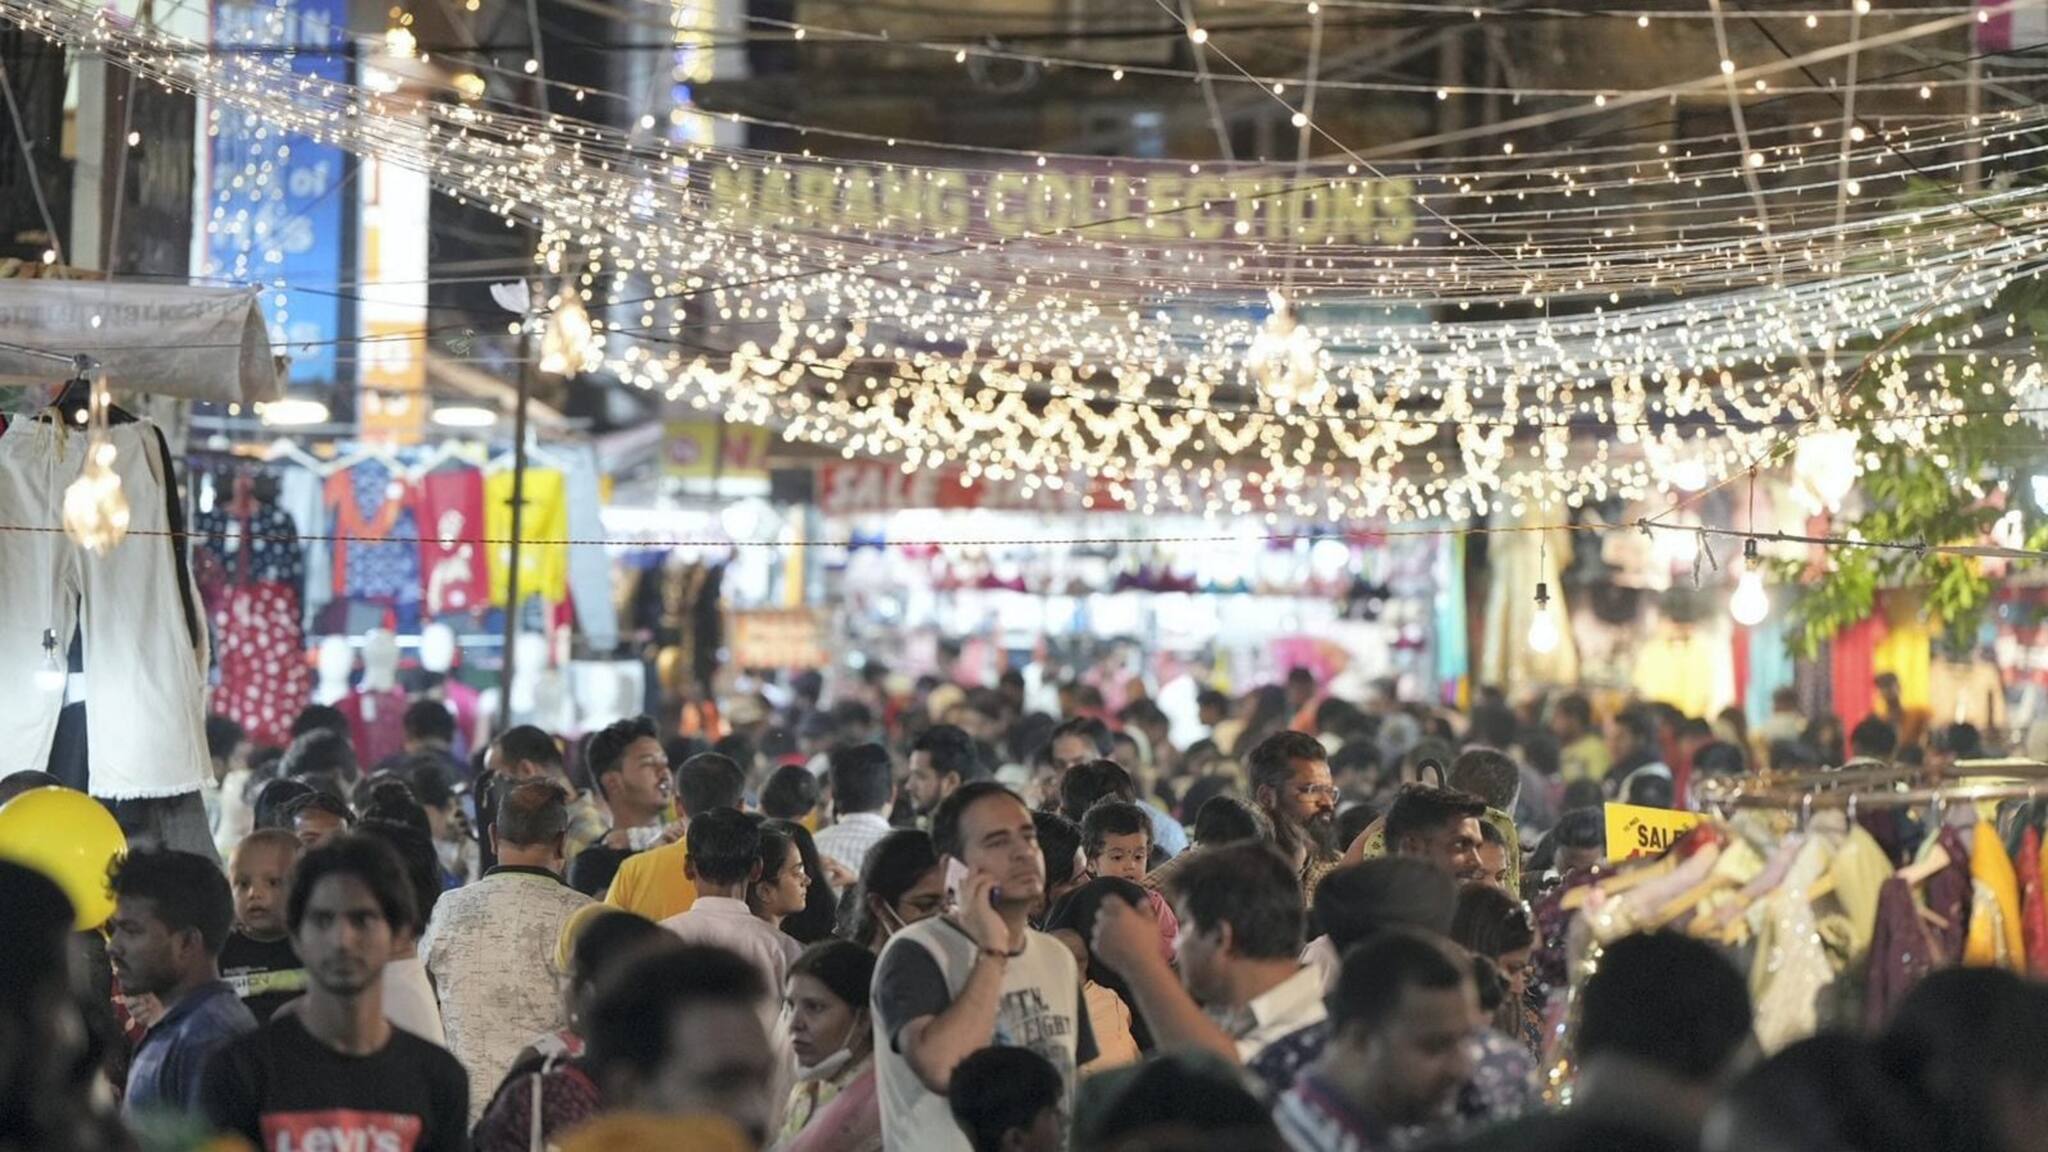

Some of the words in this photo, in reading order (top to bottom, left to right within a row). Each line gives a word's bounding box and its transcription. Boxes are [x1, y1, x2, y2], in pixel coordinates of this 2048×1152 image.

[711, 166, 970, 237] NARANG
[987, 170, 1417, 245] COLLECTIONS
[825, 461, 938, 508] SALE
